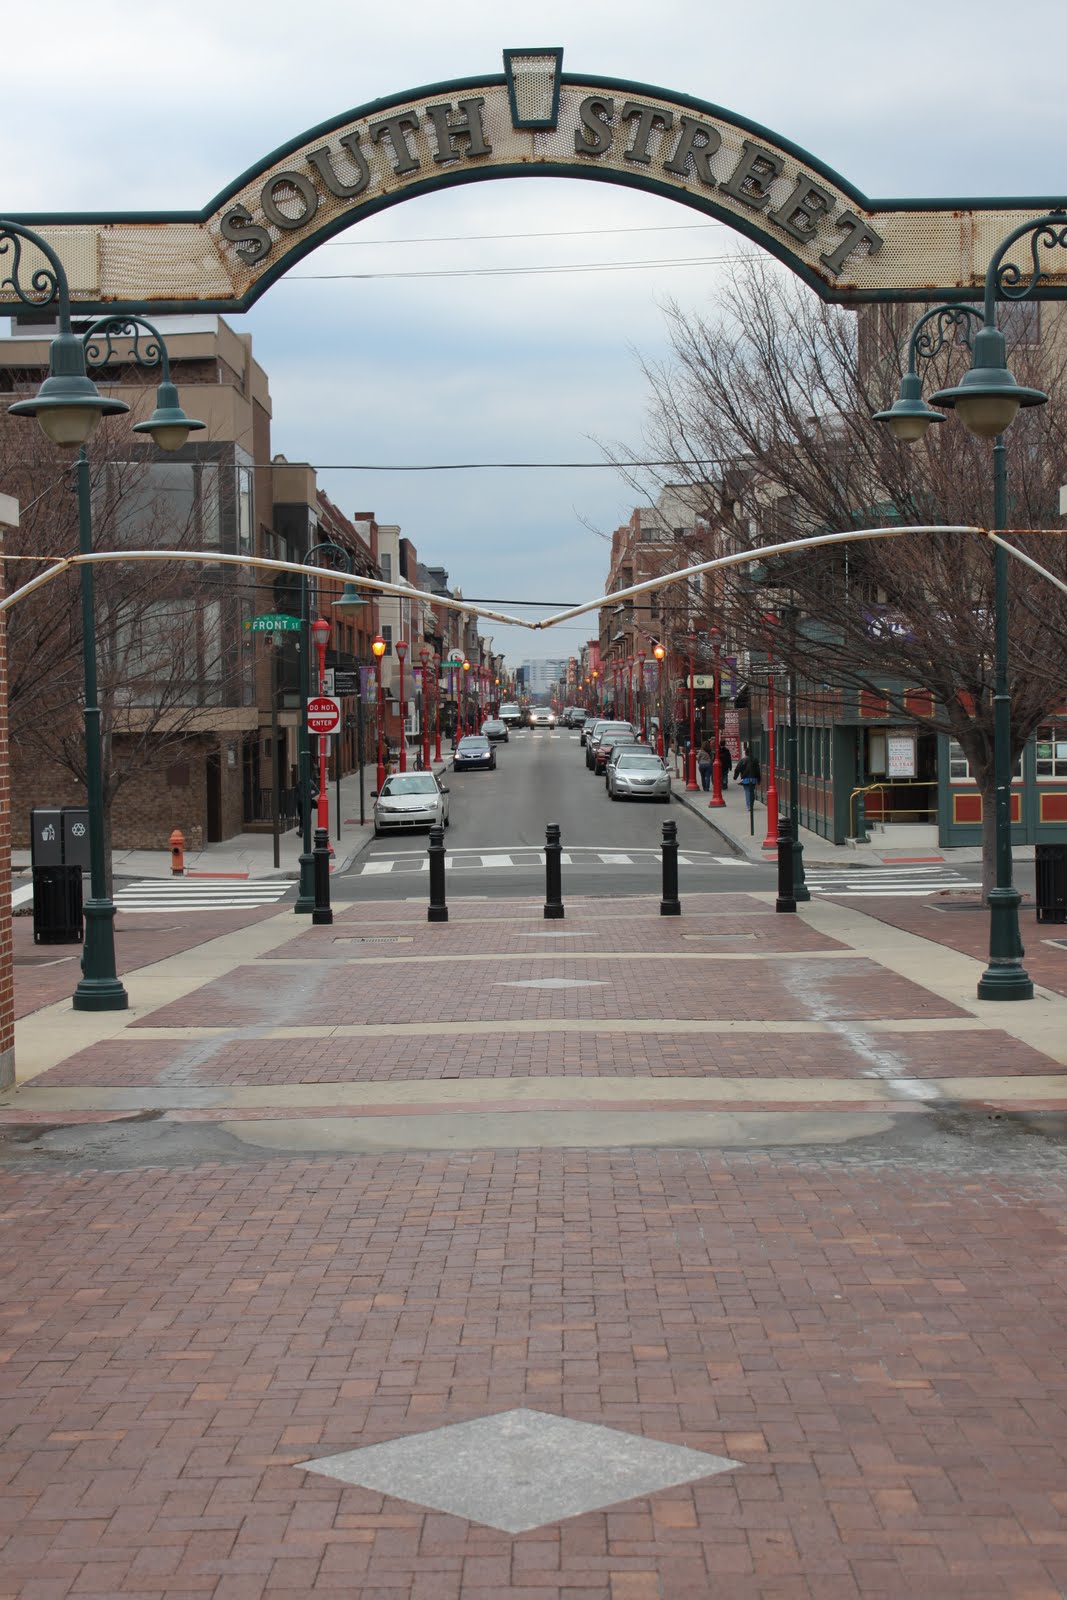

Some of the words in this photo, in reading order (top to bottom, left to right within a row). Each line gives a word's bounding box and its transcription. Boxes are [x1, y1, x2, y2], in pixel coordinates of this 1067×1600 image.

[220, 97, 493, 267] SOUTH
[574, 96, 885, 276] STREET
[252, 620, 288, 630] FRONT
